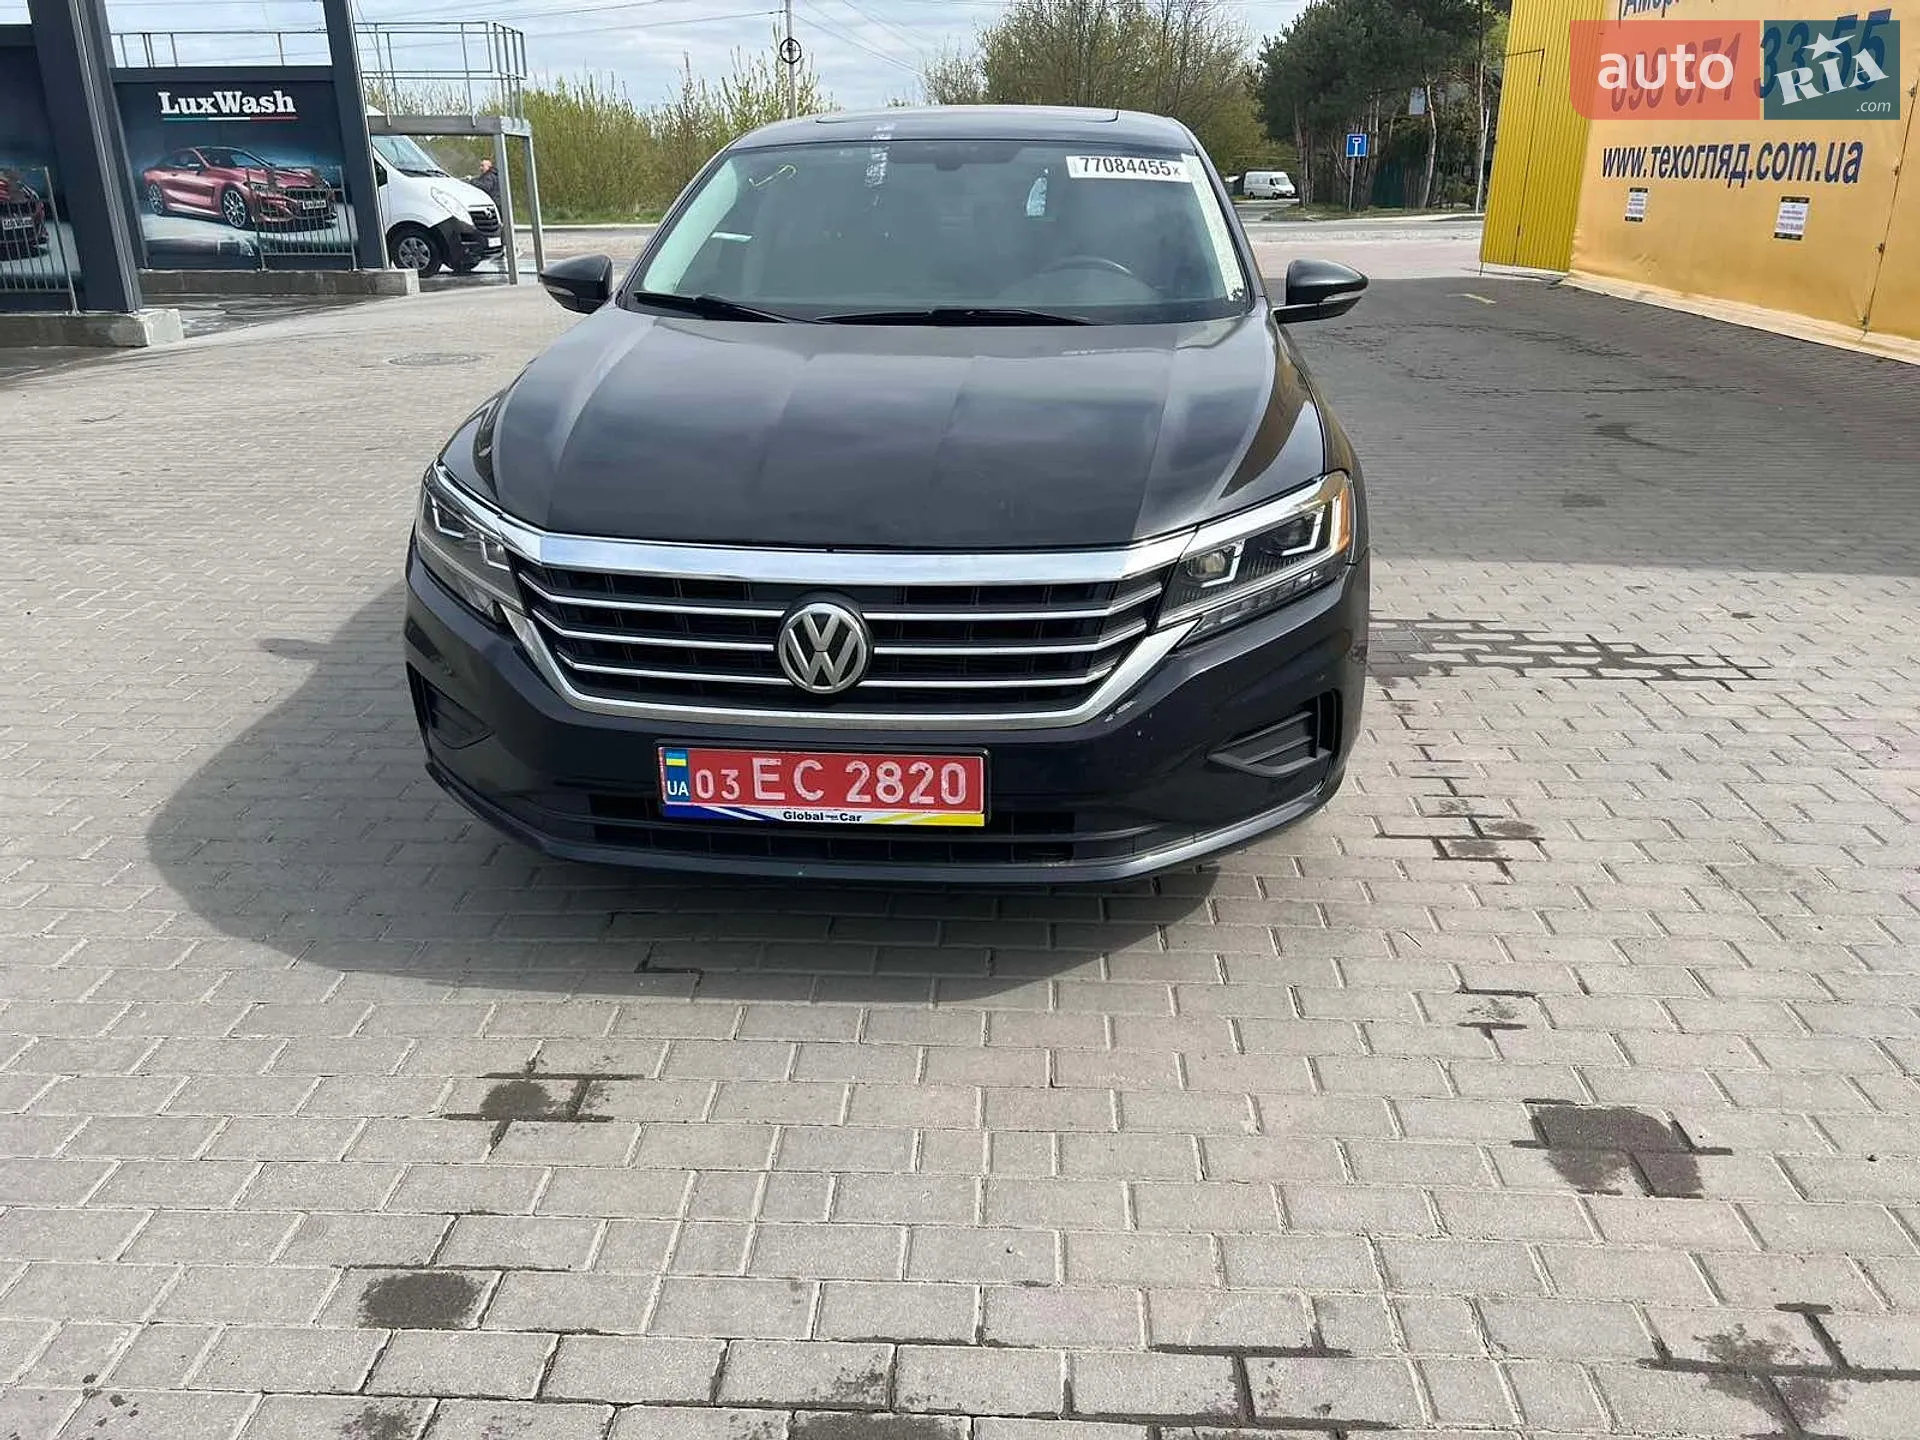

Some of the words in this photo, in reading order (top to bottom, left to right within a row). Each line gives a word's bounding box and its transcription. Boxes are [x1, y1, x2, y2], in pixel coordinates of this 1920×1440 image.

[1822, 8, 1892, 93] 55
[158, 90, 296, 114] LuxWash
[1602, 141, 1864, 188] www.техогляд.com.ua
[667, 780, 689, 797] UA
[695, 769, 741, 800] 03
[752, 757, 825, 801] EC
[845, 760, 966, 804] 2820
[783, 811, 824, 821] Global
[839, 812, 862, 822] Car
